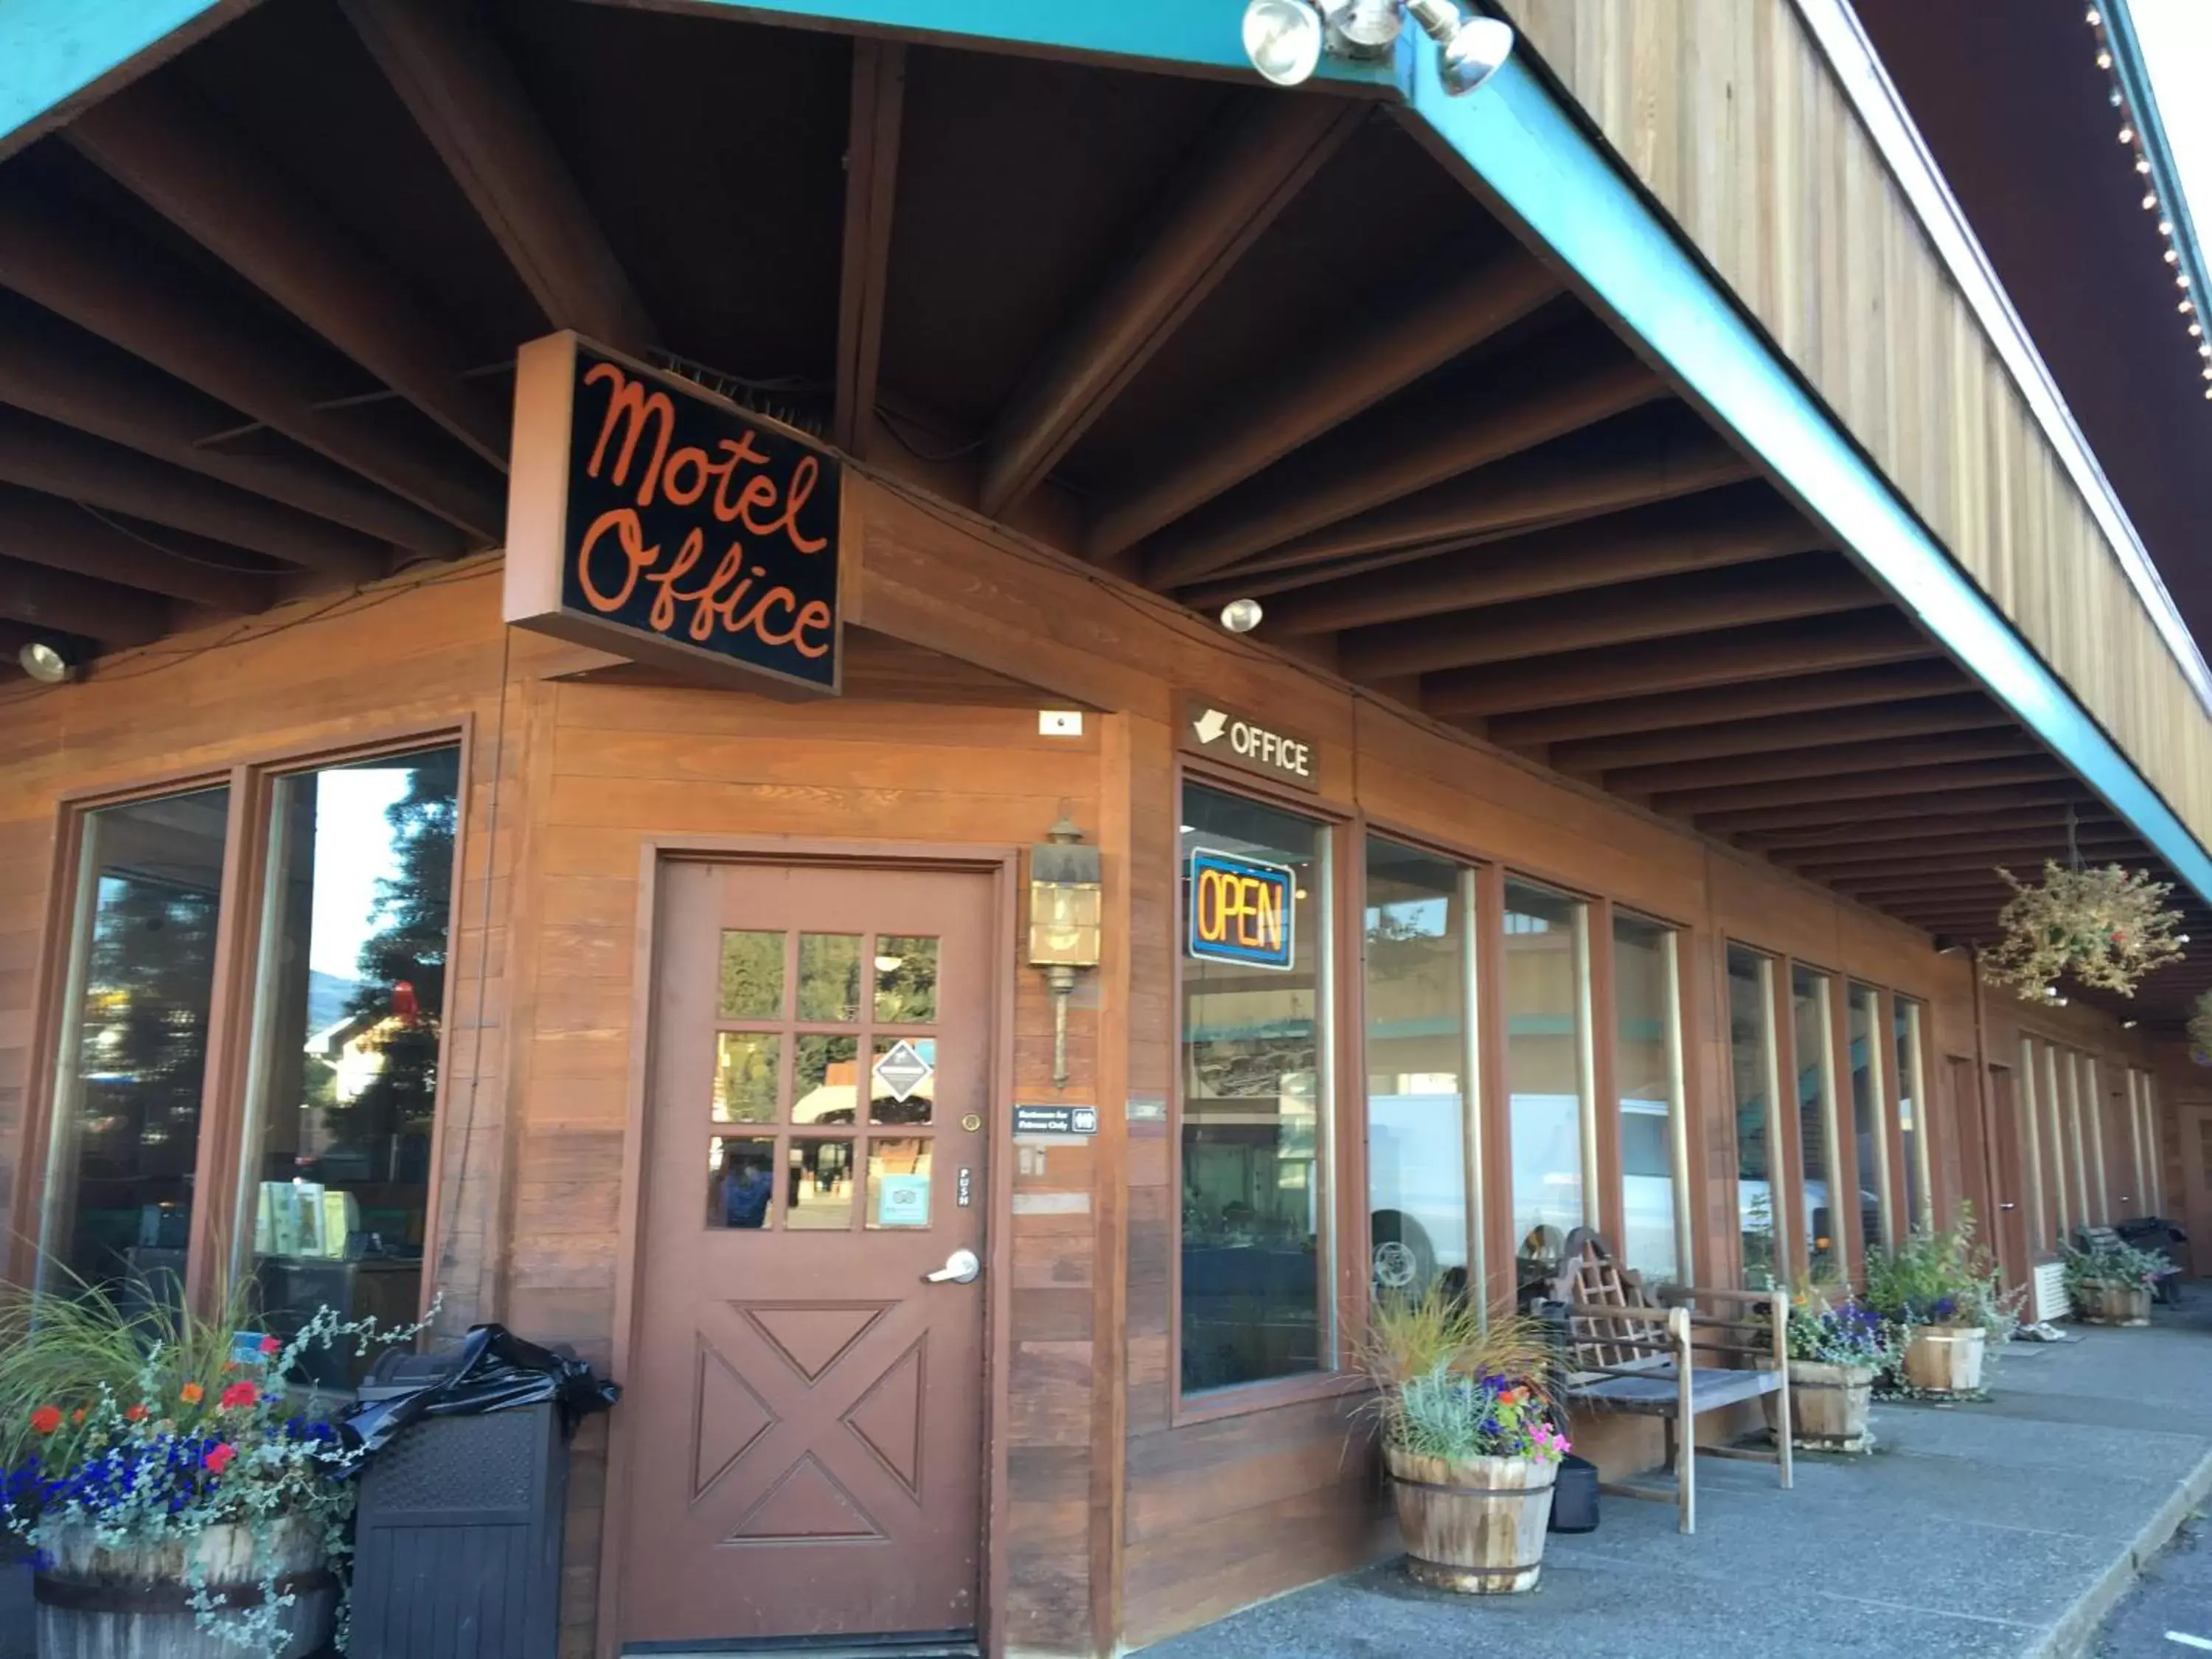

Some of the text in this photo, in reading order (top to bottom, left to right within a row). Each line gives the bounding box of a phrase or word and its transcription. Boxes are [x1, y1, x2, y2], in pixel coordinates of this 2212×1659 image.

[584, 363, 827, 554] Motel
[578, 508, 830, 658] Office
[1231, 722, 1310, 777] OFFICE
[1197, 869, 1283, 950] OPEN
